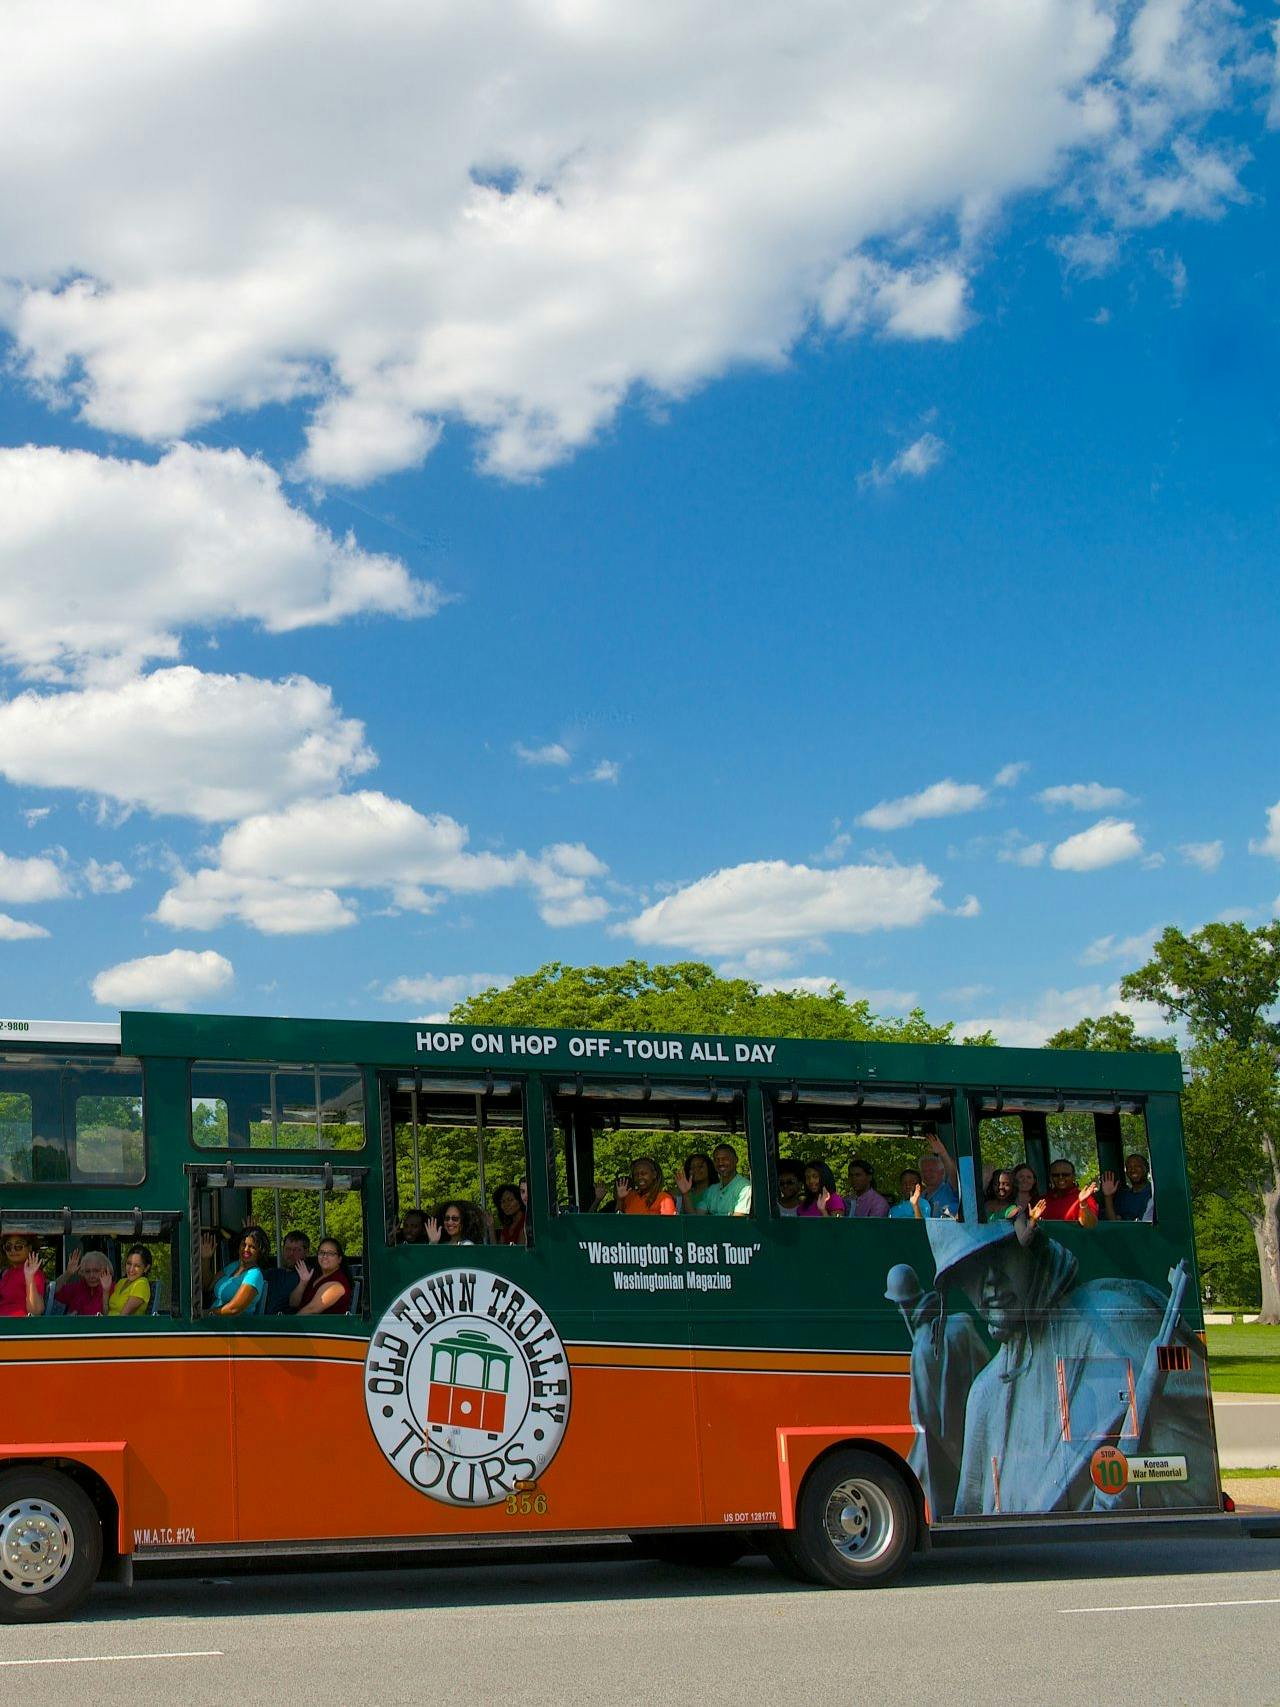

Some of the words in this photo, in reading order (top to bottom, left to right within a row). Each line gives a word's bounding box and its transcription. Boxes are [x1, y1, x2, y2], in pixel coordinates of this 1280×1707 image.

[416, 1032, 464, 1052] HOP
[471, 1033, 503, 1053] ON
[511, 1035, 558, 1055] HOP
[690, 1042, 729, 1062] ALL
[735, 1043, 776, 1063] DAY
[579, 1241, 683, 1267] "Washington's
[687, 1242, 719, 1264] Best
[722, 1242, 761, 1264] Tour"
[613, 1271, 684, 1292] Washingtonian
[686, 1271, 732, 1292] Magazine
[368, 1331, 409, 1395] OLD
[391, 1273, 477, 1335] TOWN
[487, 1278, 568, 1423] TROLLEY
[389, 1418, 537, 1503] TOURS
[1100, 1450, 1116, 1458] STOP
[1143, 1460, 1169, 1469] Korean
[1097, 1460, 1123, 1487] 10
[1132, 1469, 1147, 1479] War
[1148, 1468, 1182, 1478] Memorial
[505, 1494, 548, 1516] 356
[723, 1513, 734, 1522] US
[734, 1512, 750, 1522] DOT
[750, 1511, 777, 1521] 1281776
[133, 1528, 175, 1545] W.M.A.T.C.
[176, 1528, 195, 1543] #124
